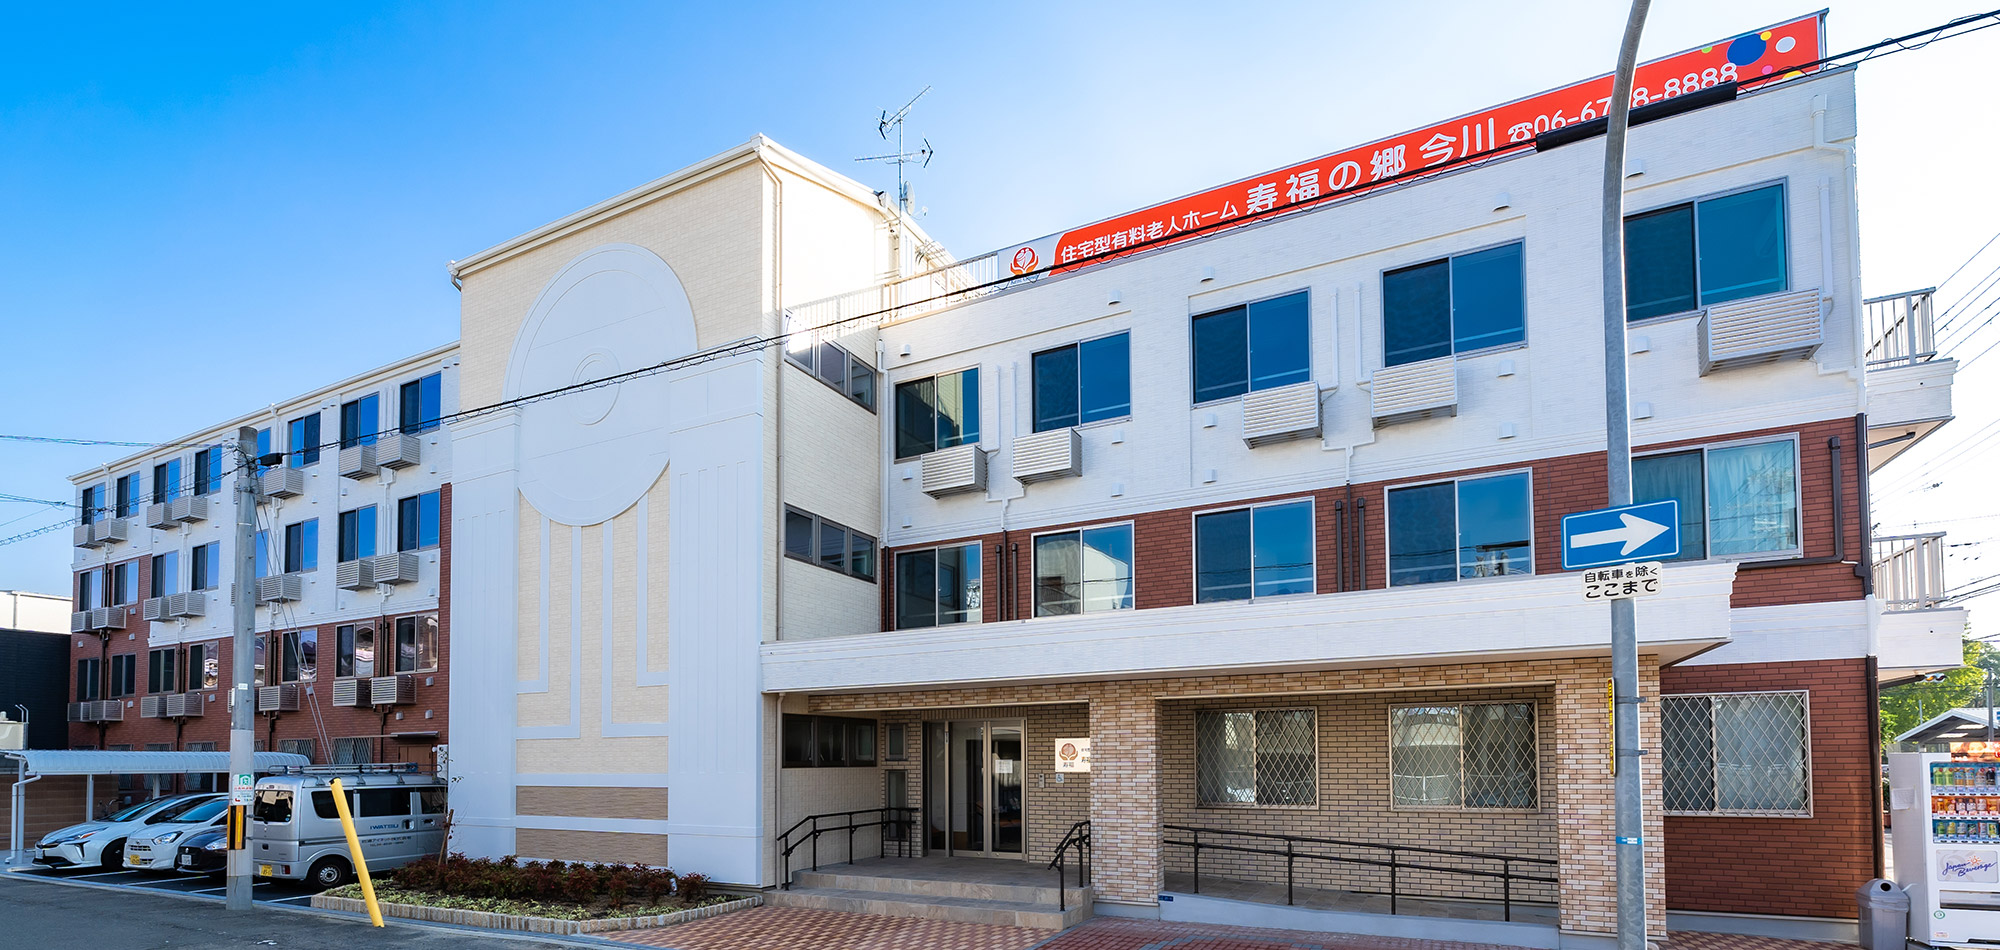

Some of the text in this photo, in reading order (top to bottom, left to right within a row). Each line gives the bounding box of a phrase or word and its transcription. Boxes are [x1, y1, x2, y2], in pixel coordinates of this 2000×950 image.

[1061, 200, 1238, 263] 住宅型有料老人ホーム
[1418, 117, 1496, 168] 今川
[1534, 62, 1739, 136] 06-678-8888
[1584, 565, 1658, 583] 自転車を除く
[1585, 578, 1658, 599] ここまで
